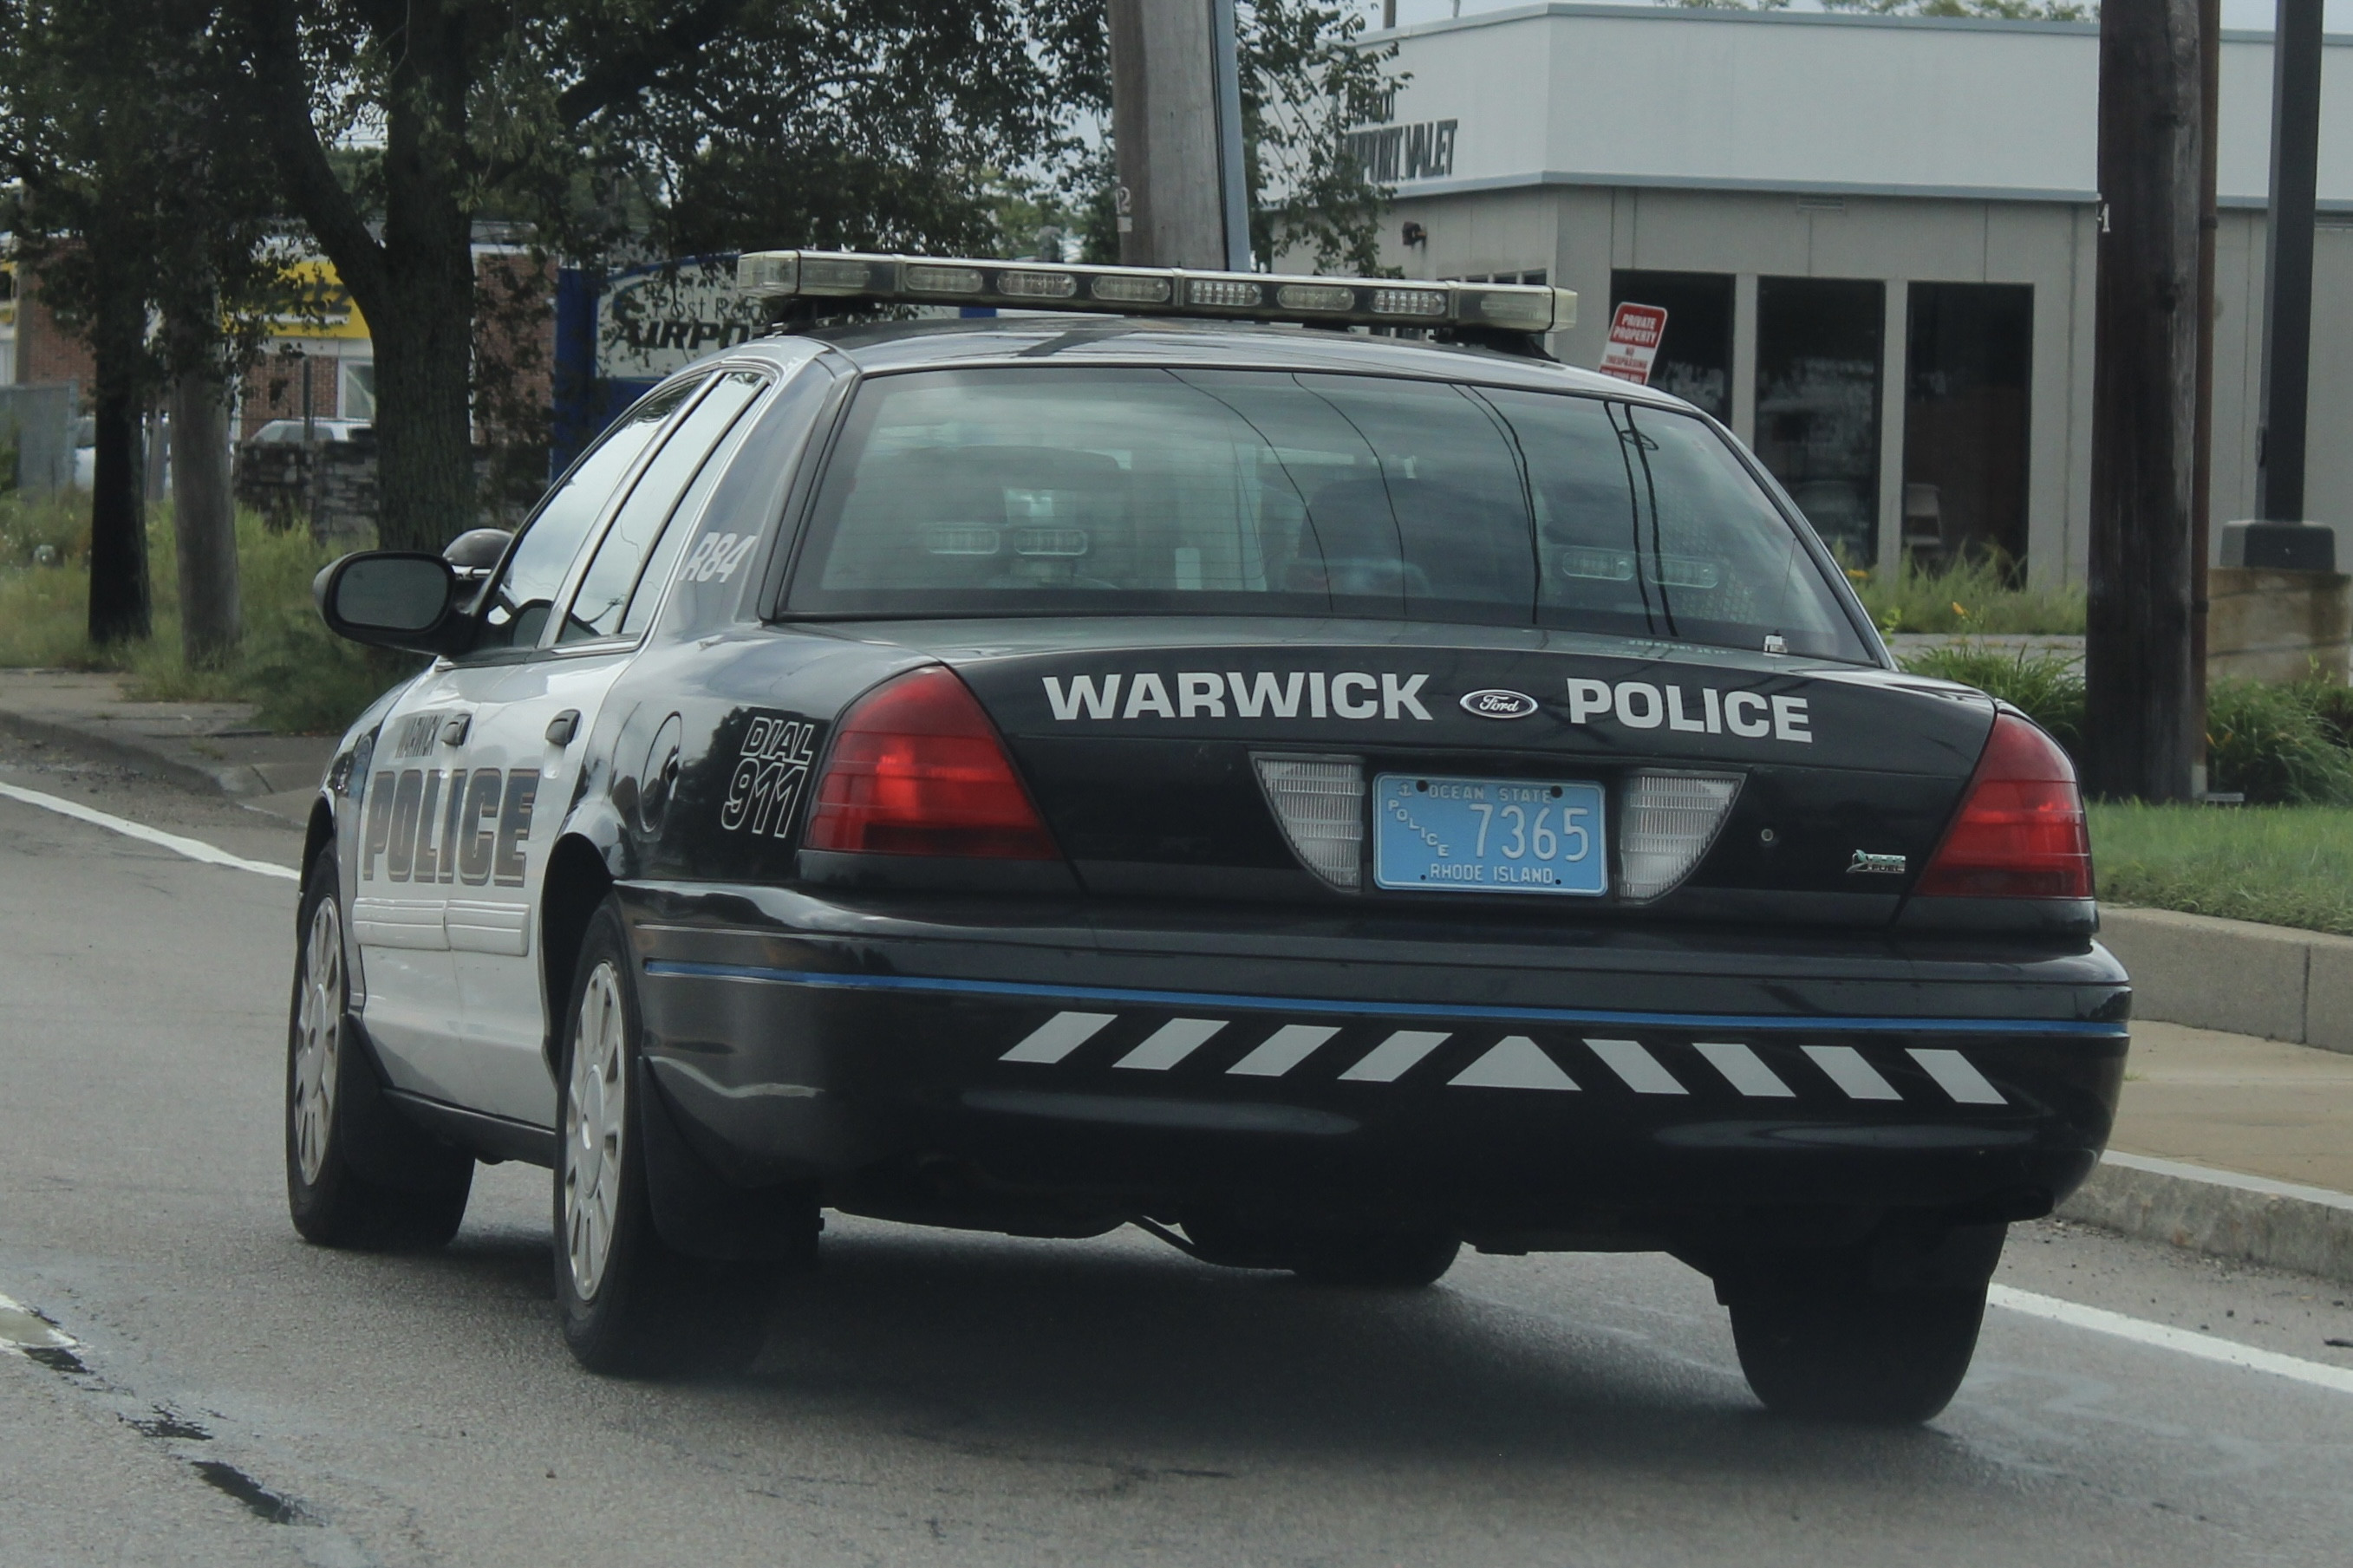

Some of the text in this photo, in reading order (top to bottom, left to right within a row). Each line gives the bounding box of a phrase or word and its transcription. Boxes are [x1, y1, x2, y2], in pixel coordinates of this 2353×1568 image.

[1613, 326, 1658, 344] PROPERTY
[1621, 314, 1657, 329] PRIVATE
[678, 531, 758, 583] R84
[1041, 671, 1434, 721] WARWICK
[1478, 694, 1520, 713] Ford
[1566, 677, 1813, 744] POLICE
[740, 716, 815, 765] DIAL
[720, 757, 808, 839] 911
[1428, 784, 1552, 804] OCEAN STATE
[362, 767, 540, 888] POLICE
[1388, 799, 1450, 857] POLICE
[1469, 803, 1589, 862] 7365
[1431, 863, 1554, 884] RHODE ISLAND
